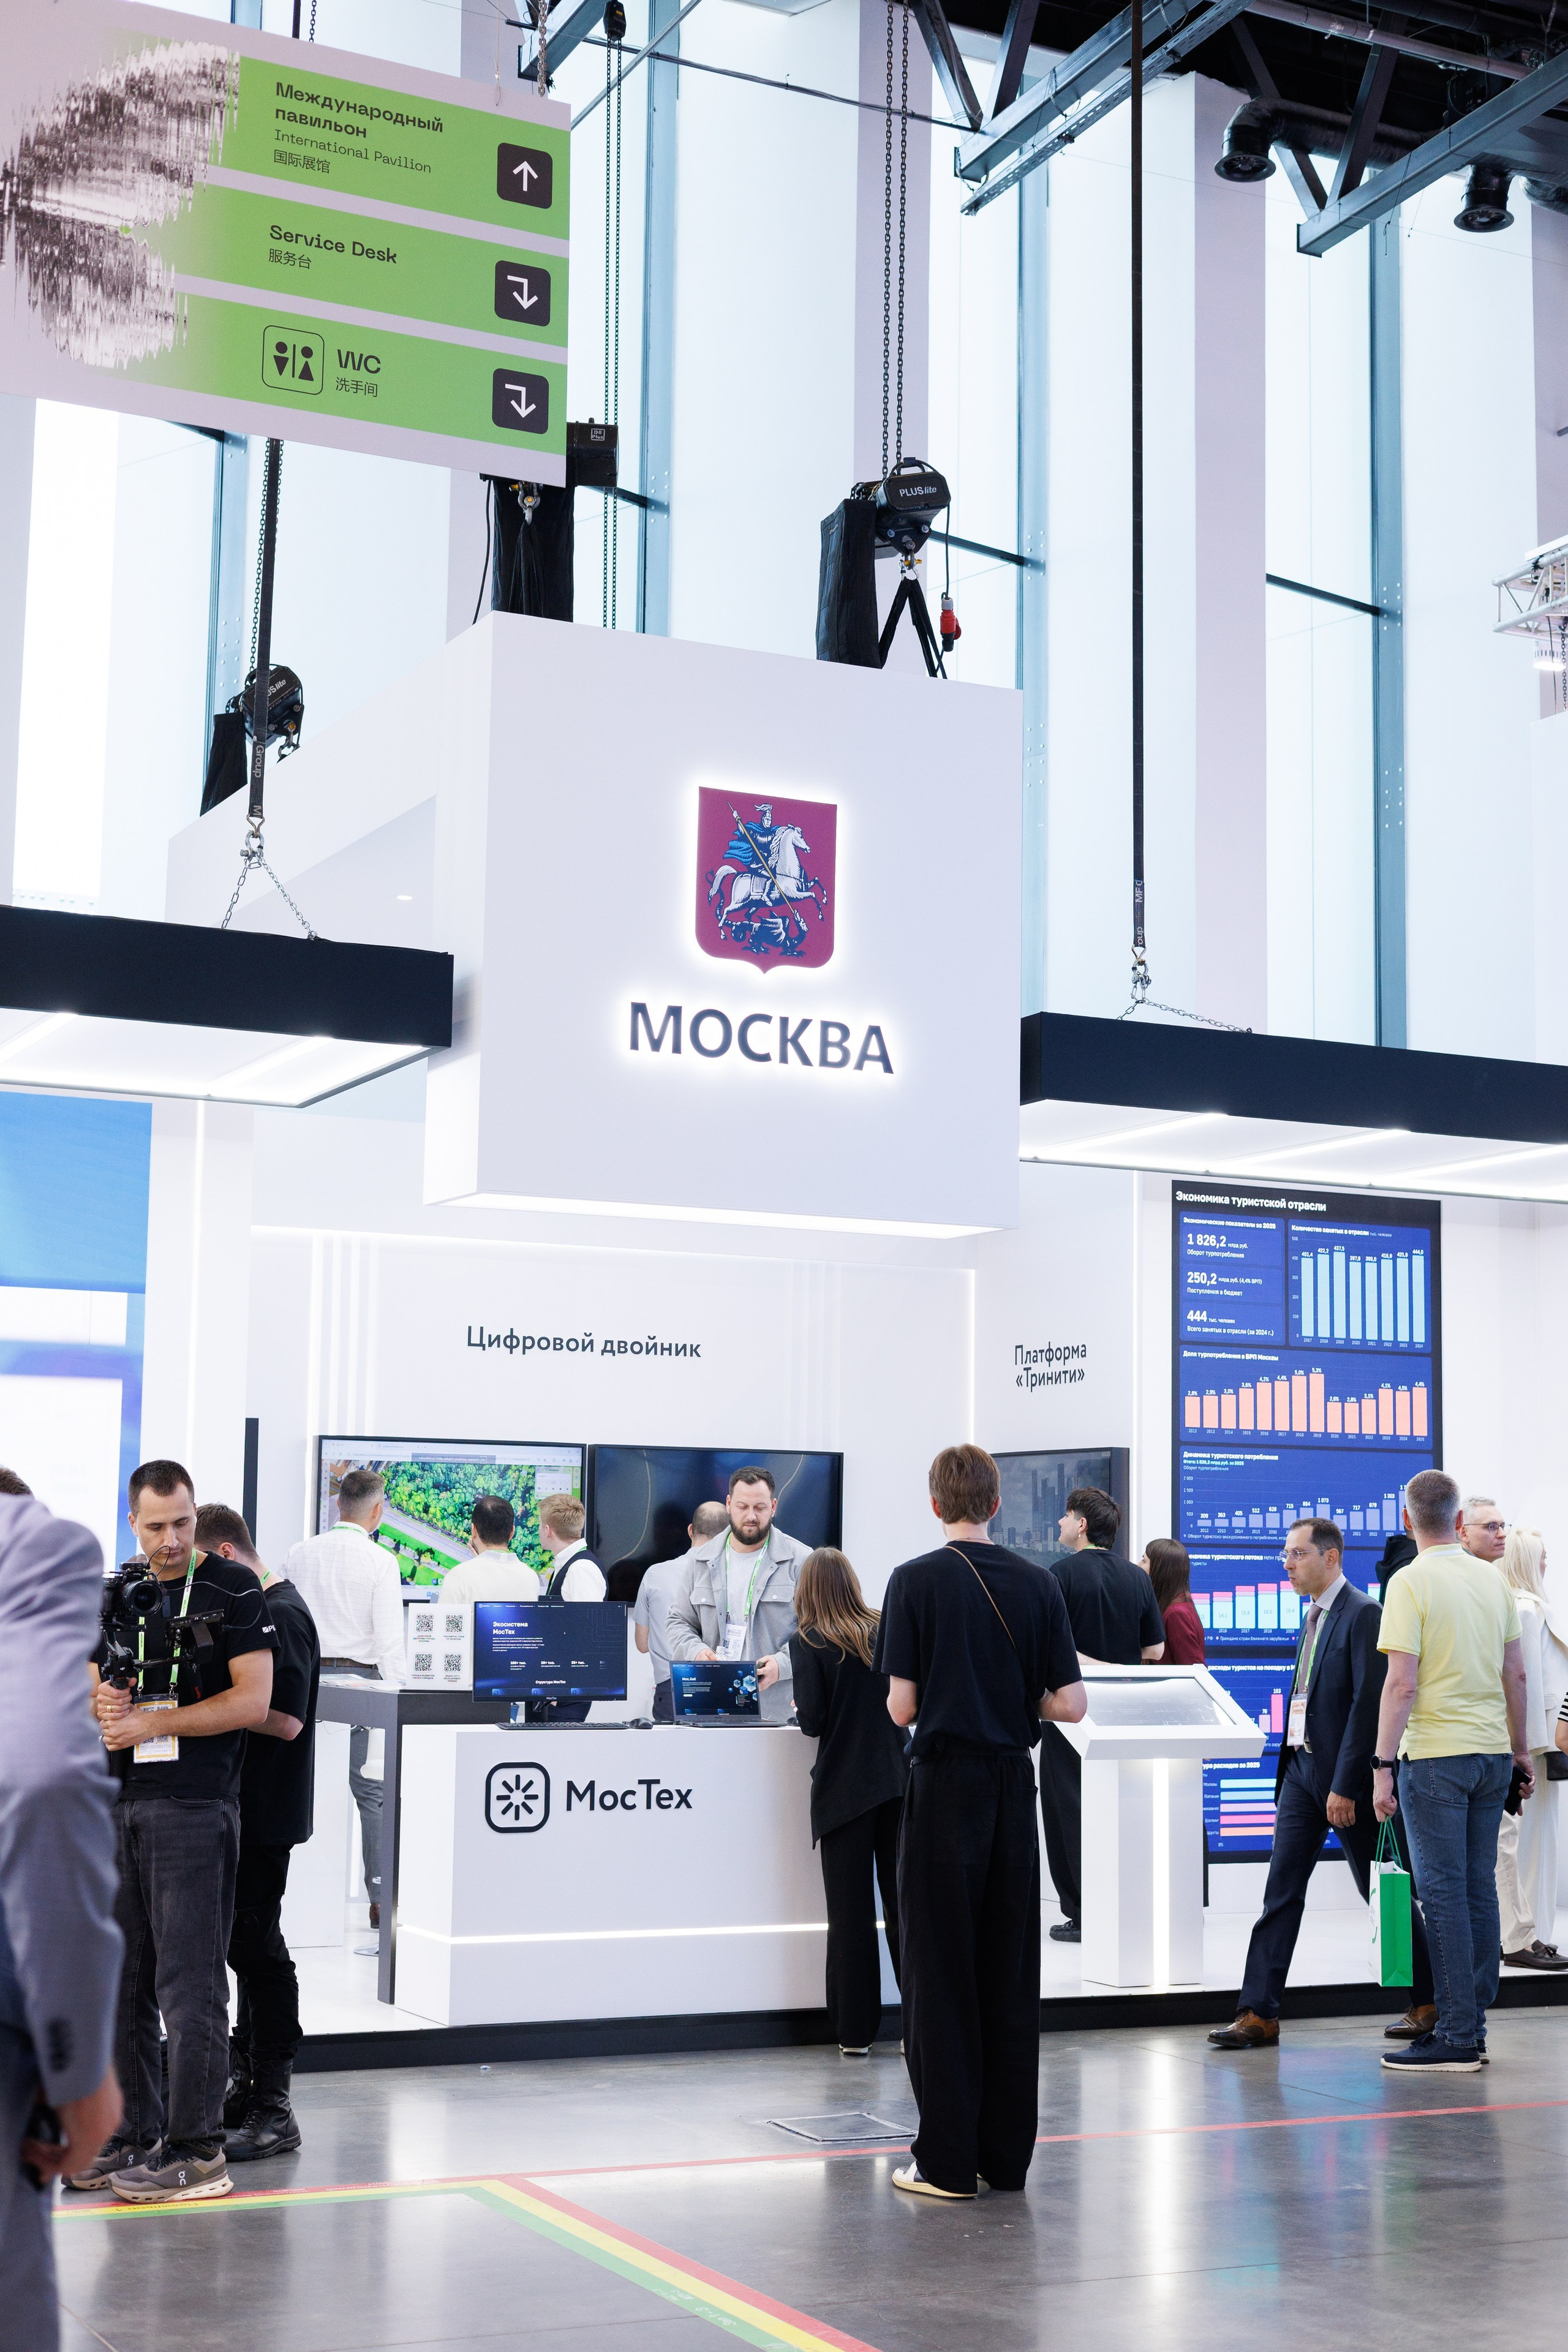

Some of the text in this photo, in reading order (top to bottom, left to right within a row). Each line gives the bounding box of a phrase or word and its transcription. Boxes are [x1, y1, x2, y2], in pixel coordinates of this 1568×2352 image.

[276, 81, 443, 133] Международный
[275, 108, 367, 138] павильон
[274, 129, 431, 173] International Pavilion
[274, 149, 331, 174] 国际展馆
[270, 224, 397, 264] Service Desk
[268, 248, 311, 270] 服务台
[337, 349, 381, 374] WC
[336, 377, 378, 398] 洗手间
[255, 744, 265, 778] Group
[630, 1001, 894, 1074] МОСКВА
[1176, 1191, 1327, 1212] Экономика туристской отрасли
[1183, 1217, 1225, 1226] Экономические
[1187, 1234, 1194, 1245] 1
[1197, 1234, 1226, 1248] 826,2
[1187, 1272, 1217, 1286] 250,2
[1187, 1310, 1207, 1322] 444
[467, 1326, 701, 1357] Цифровой двойник
[1015, 1341, 1087, 1367] Платформа
[1016, 1366, 1085, 1392] «Тринити»
[566, 1779, 693, 1811] МосТех
